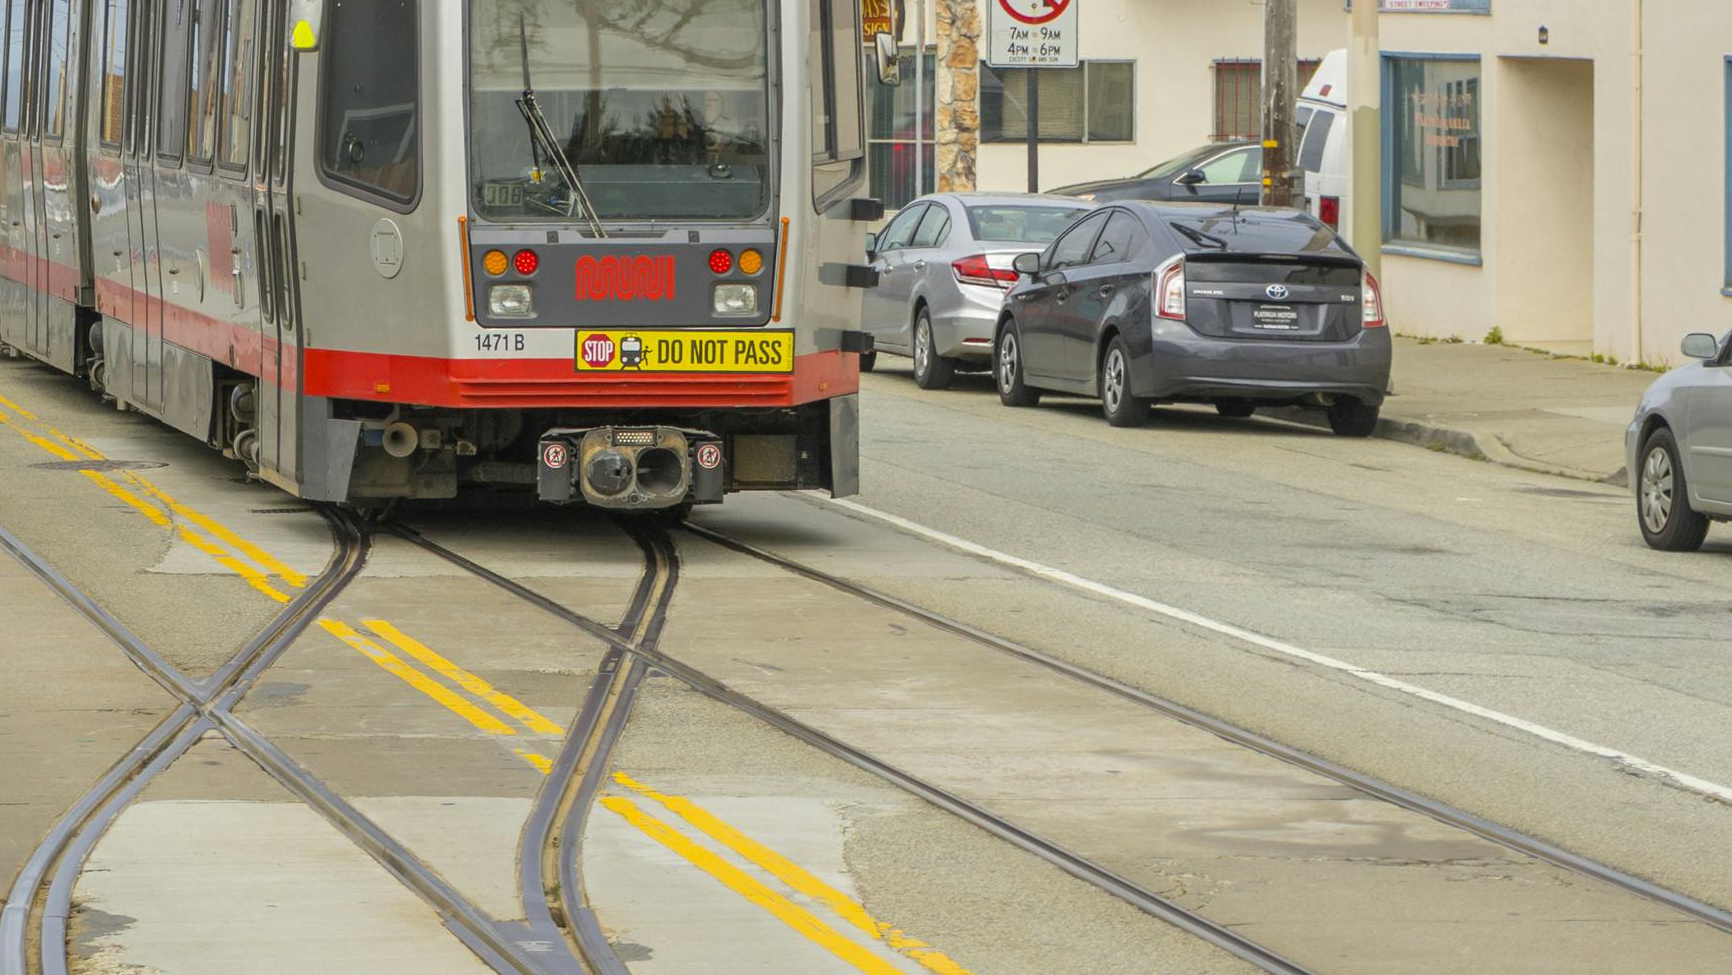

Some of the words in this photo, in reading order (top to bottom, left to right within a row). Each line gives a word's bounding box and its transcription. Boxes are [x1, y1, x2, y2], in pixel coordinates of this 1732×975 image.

[475, 334, 510, 351] 1471
[514, 333, 525, 351] B
[584, 341, 614, 362] STOP
[657, 340, 683, 364] DO
[690, 340, 728, 364] NOT
[734, 340, 783, 364] PASS
